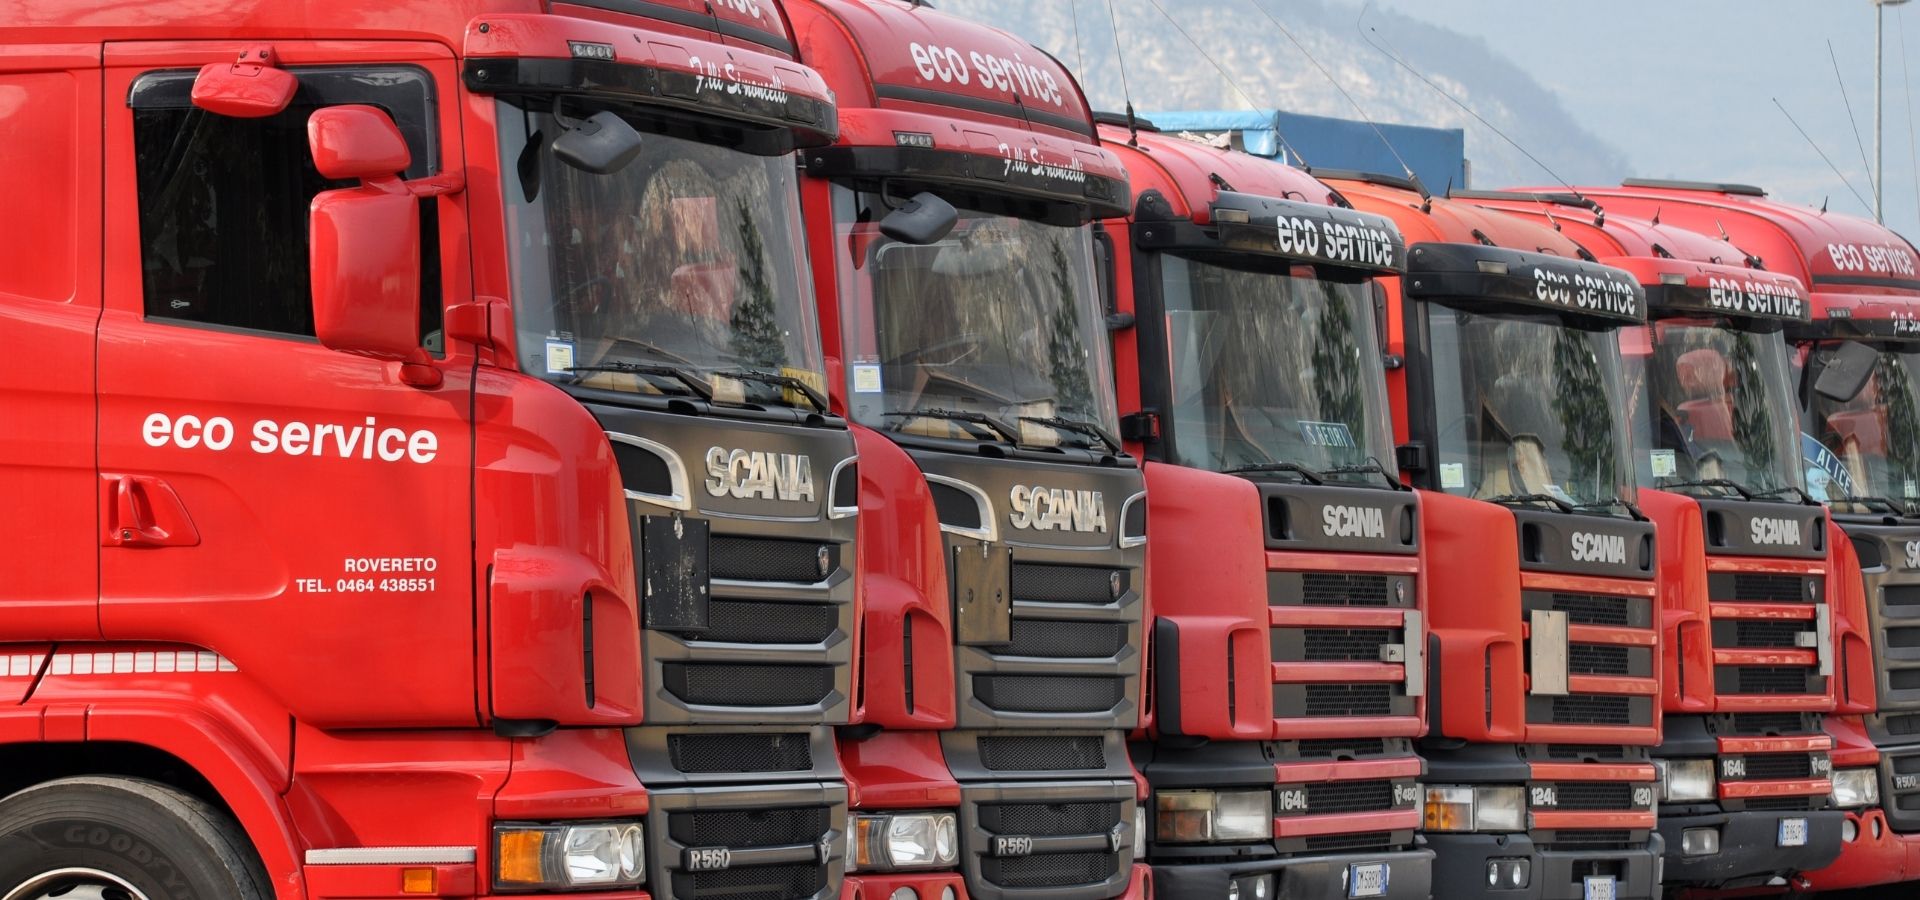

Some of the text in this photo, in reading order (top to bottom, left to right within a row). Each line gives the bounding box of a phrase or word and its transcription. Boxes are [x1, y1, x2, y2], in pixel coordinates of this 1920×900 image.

[724, 63, 788, 104] Simoncelli
[910, 42, 1062, 107] eco service
[1030, 148, 1086, 183] Simoncelli
[1276, 215, 1393, 267] eco service
[1828, 241, 1915, 276] eco service
[1534, 267, 1636, 315] eco service
[1709, 277, 1801, 316] eco service
[142, 412, 438, 464] eco service
[705, 446, 815, 502] SCANIA
[1816, 448, 1852, 494] ALICE
[1009, 484, 1107, 533] SCANIA
[1322, 504, 1385, 538] SCANIA
[1570, 531, 1626, 565] SCANIA
[1750, 516, 1801, 546] SCANIA
[344, 557, 437, 572] ROVERETO
[296, 577, 436, 593] TEL. 0464 438551
[1634, 787, 1652, 805] 420
